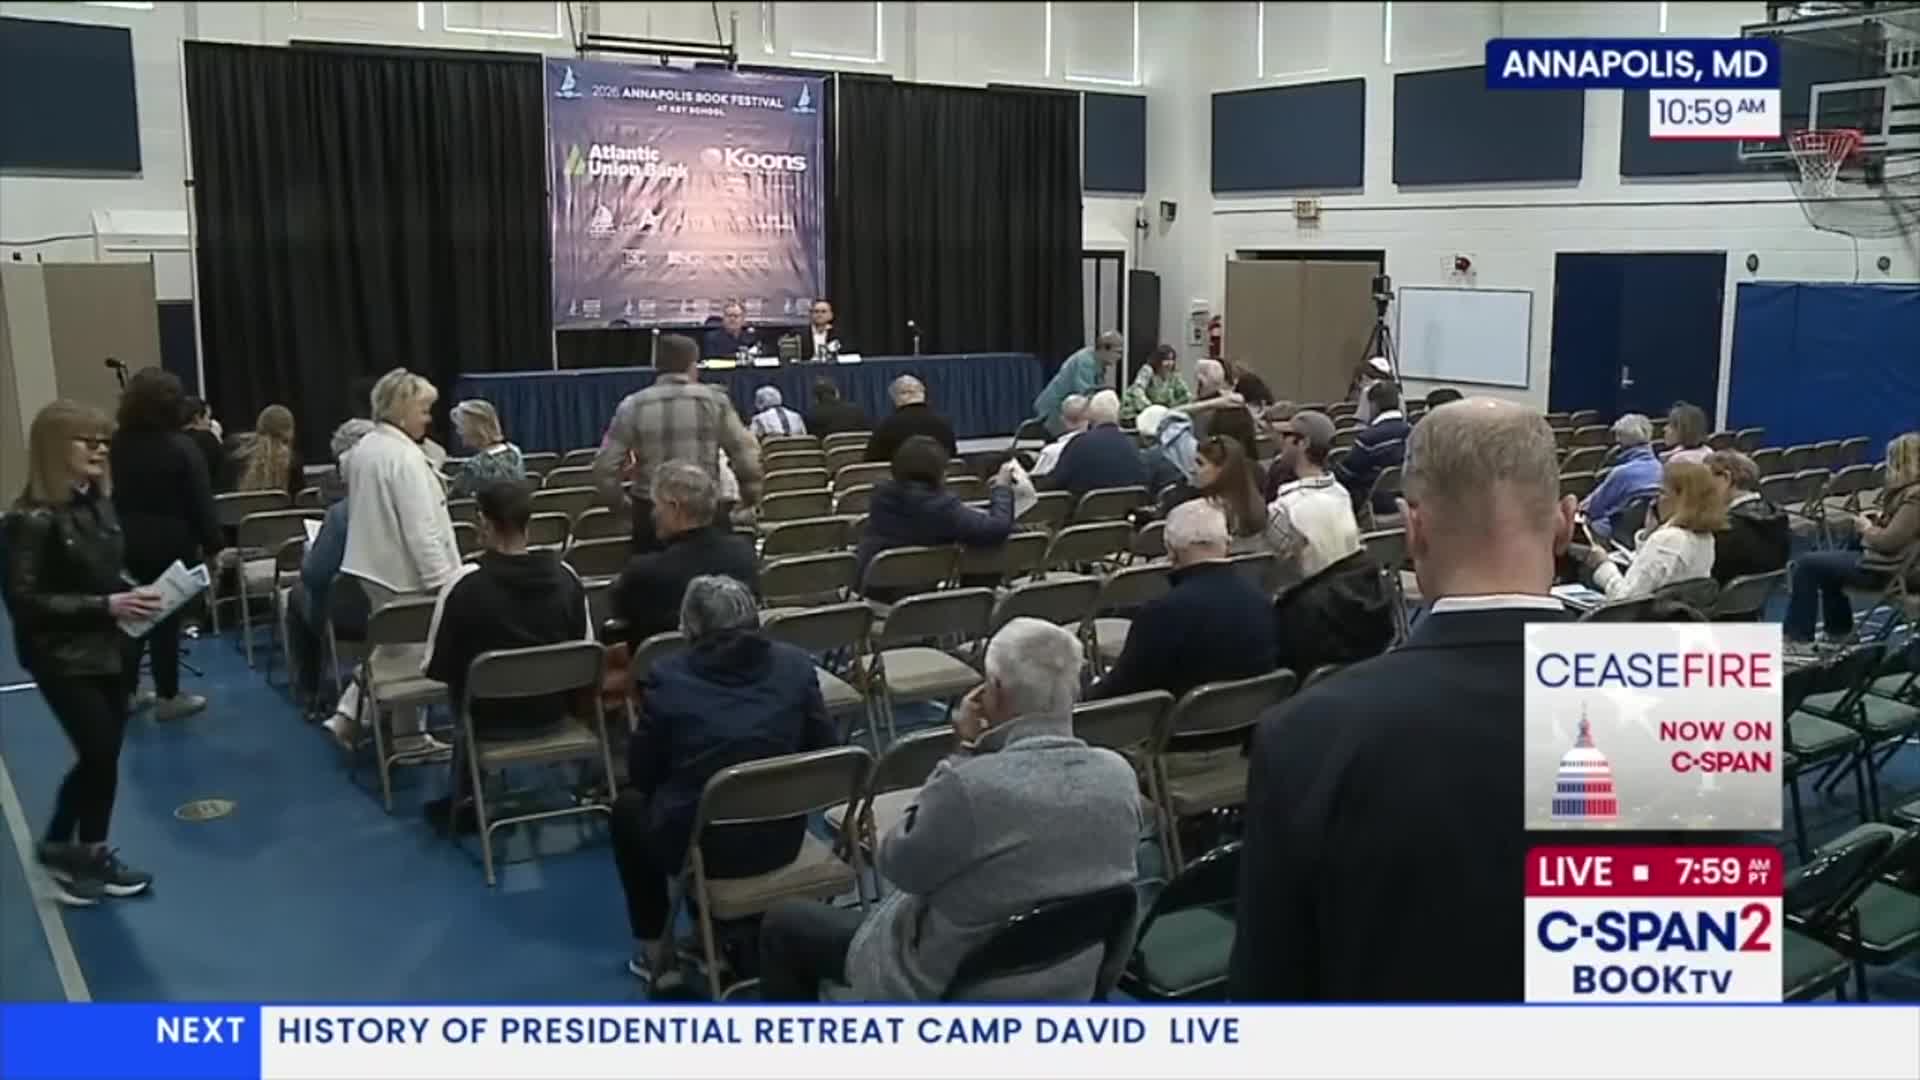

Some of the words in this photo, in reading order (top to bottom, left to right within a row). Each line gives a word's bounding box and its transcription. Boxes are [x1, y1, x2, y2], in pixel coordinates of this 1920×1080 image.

[622, 87, 693, 102] ANNAPOLIS
[695, 91, 729, 105] BOOK
[730, 94, 784, 109] FESTIVAL
[656, 104, 668, 112] AT
[590, 144, 660, 161] Atlantic
[725, 147, 807, 172] Koons
[589, 160, 640, 177] Union
[643, 162, 688, 178] Bank
